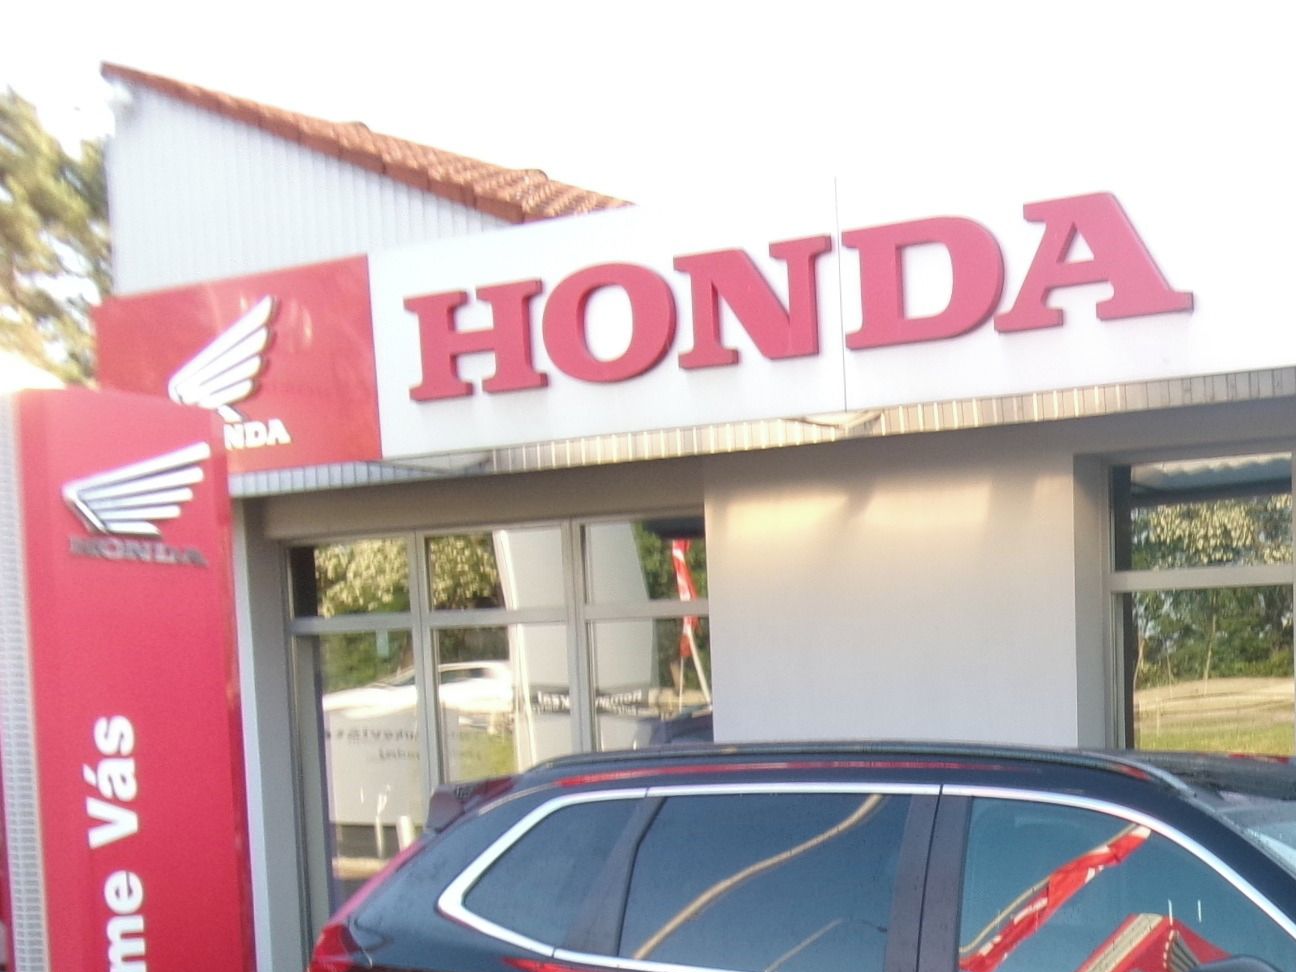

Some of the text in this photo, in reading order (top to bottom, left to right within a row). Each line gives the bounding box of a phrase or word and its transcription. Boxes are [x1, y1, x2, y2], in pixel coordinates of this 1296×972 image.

[403, 192, 1194, 401] HONDA
[223, 418, 291, 449] NDA
[69, 536, 208, 567] HONDA
[83, 715, 139, 849] Vás
